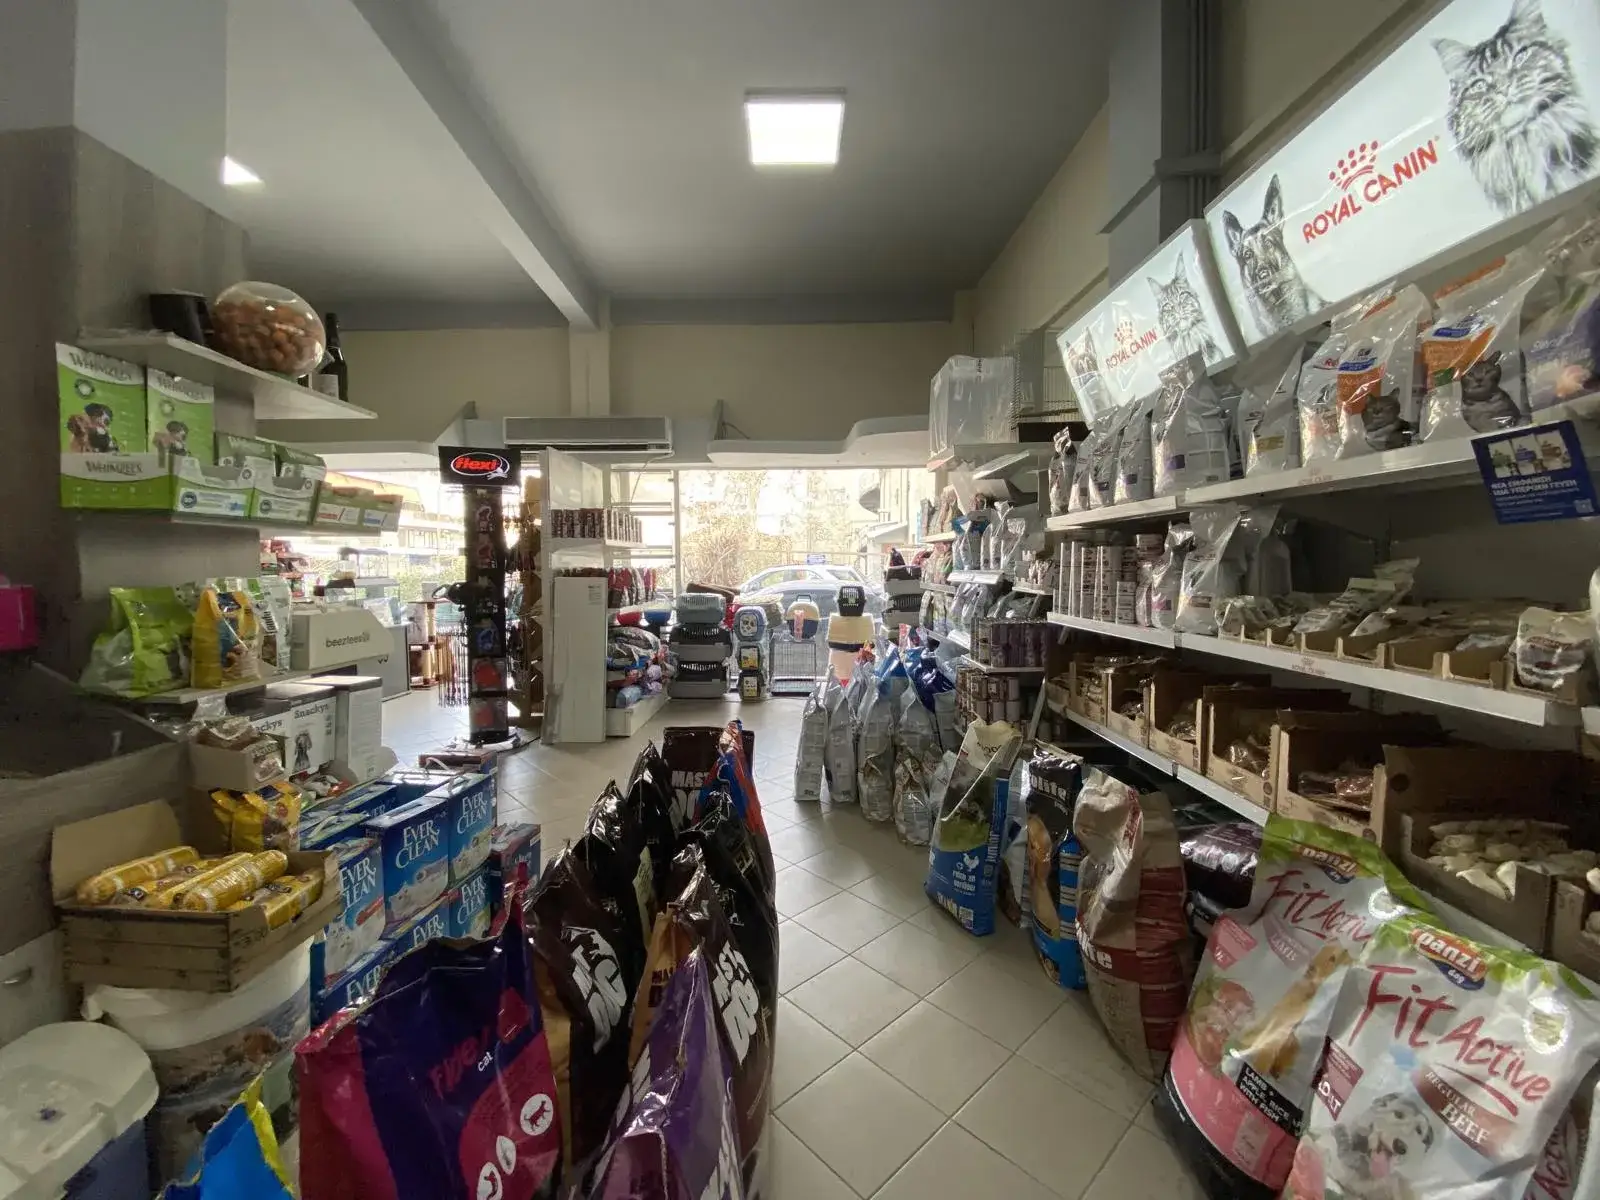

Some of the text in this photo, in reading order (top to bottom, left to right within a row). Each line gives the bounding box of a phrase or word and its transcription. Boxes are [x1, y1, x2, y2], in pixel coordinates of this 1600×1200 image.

[1302, 139, 1438, 244] ROYAL CANIN
[1105, 327, 1158, 369] ROYAL CANIN
[455, 457, 498, 471] flexi
[255, 719, 283, 733] ackys
[294, 702, 329, 720] Snackys
[456, 805, 487, 835] CLEAN
[462, 791, 488, 816] EVER
[403, 819, 441, 849] EVER
[395, 834, 440, 869] CLEAN
[339, 857, 377, 892] EVER
[461, 875, 487, 906] EVER
[336, 873, 377, 918] LEAN
[1249, 868, 1331, 927] Fit
[412, 914, 445, 948] EVER
[1416, 930, 1482, 975] panzi
[1447, 967, 1465, 985] dog
[1348, 962, 1458, 1049] Fit
[1436, 1014, 1552, 1104] Active
[477, 1051, 494, 1072] cat
[1424, 1070, 1477, 1118] REGULAR
[1440, 1102, 1491, 1145] BEEF
